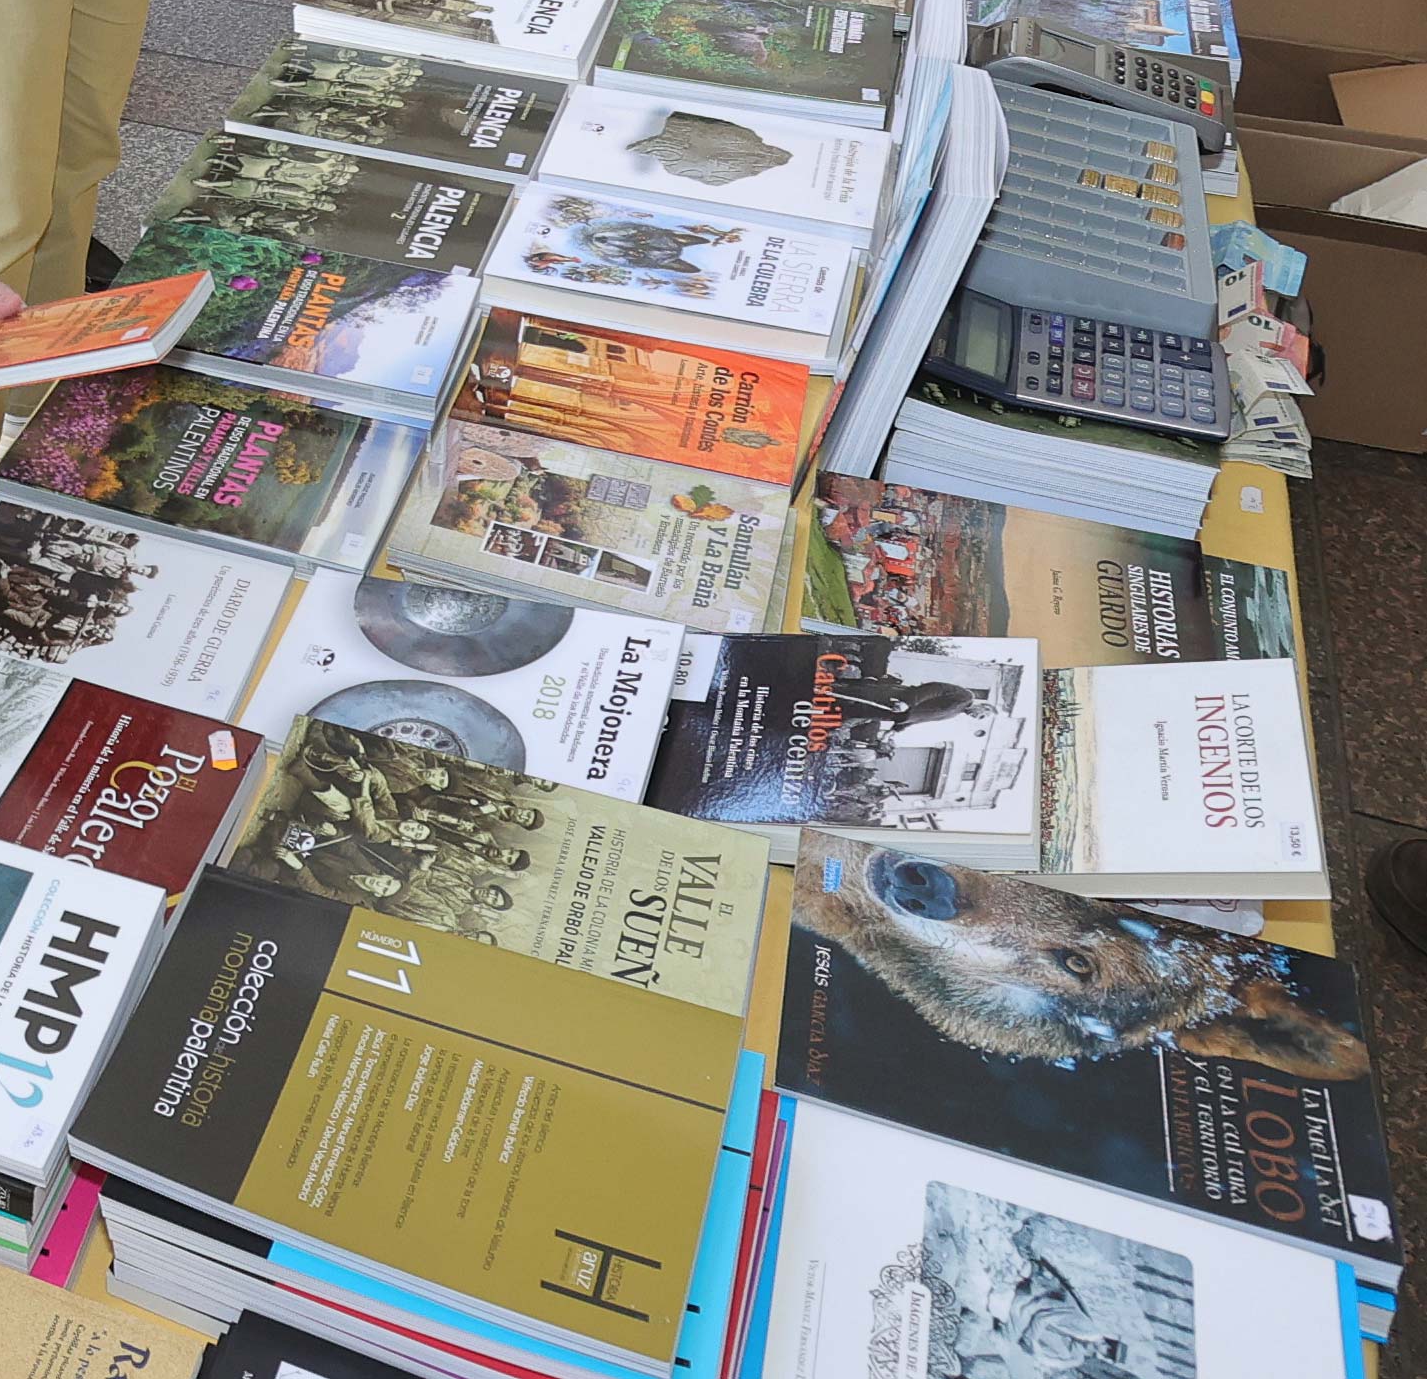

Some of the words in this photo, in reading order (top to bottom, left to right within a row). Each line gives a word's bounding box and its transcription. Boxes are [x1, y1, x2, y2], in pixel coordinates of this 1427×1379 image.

[452, 107, 466, 115] 2
[467, 85, 524, 151] PALENCIA
[390, 211, 406, 220] 2
[403, 184, 466, 262] PALENCIA
[759, 248, 781, 262] LA
[764, 235, 785, 249] DE
[276, 266, 305, 302] MONTAÑA
[299, 278, 313, 290] USO
[304, 269, 318, 280] DE
[744, 261, 777, 308] CULEBRA
[766, 259, 815, 316] SIERRA
[256, 299, 287, 340] PALENTINA
[280, 288, 308, 325] TRADICIONAL
[285, 270, 347, 350] PLANTAS
[271, 333, 284, 343] LA
[275, 324, 290, 335] EN
[713, 365, 735, 387] de
[707, 386, 729, 409] los
[730, 369, 761, 426] Carrión
[200, 410, 240, 456] PÁRAMOS
[226, 425, 246, 443] USO
[235, 415, 252, 428] DE
[696, 408, 725, 455] Condes
[151, 403, 220, 493] PALENTINOS
[195, 452, 212, 462] Y
[199, 439, 237, 489] TRADICIONAL
[209, 417, 284, 509] PLANTAS
[174, 458, 208, 496] VALLES
[192, 486, 210, 500] EN
[705, 524, 727, 536] y
[703, 538, 728, 558] La
[721, 514, 764, 590] Santullán
[690, 561, 725, 609] Braña
[1219, 571, 1234, 588] EL
[219, 578, 251, 620] DIARIO
[1094, 560, 1130, 648] GUARDO
[1125, 564, 1149, 634] SINGULARES
[1148, 569, 1179, 658] HISTORIAS
[1216, 585, 1239, 643] CONJUNTO
[210, 618, 231, 637] DE
[1133, 635, 1150, 653] DE
[186, 634, 223, 685] GUERRA
[620, 635, 650, 667] La
[674, 650, 693, 686] 10.80
[531, 673, 566, 721] 2018
[737, 688, 751, 698] la
[739, 676, 750, 687] en
[731, 698, 749, 736] Montaña
[751, 685, 769, 721] Historia
[790, 699, 825, 729] de
[803, 651, 851, 754] Castillos
[1230, 693, 1252, 710] LA
[104, 713, 132, 747] Historia
[580, 667, 642, 783] Mojonera
[747, 734, 761, 747] los
[750, 722, 764, 733] de
[1154, 721, 1169, 745] Ignacio
[1233, 715, 1258, 766] CORTE
[93, 755, 108, 766] la
[98, 745, 114, 757] de
[723, 737, 743, 779] Palentina
[743, 748, 759, 771] cines
[1156, 747, 1172, 772] Martín
[1192, 694, 1238, 828] INGENIOS
[76, 764, 103, 795] minería
[125, 743, 207, 828] Pozo
[780, 734, 819, 806] ceniza
[1159, 774, 1173, 800] Verona
[1239, 771, 1260, 793] DE
[65, 804, 80, 814] el
[70, 793, 84, 805] en
[1242, 797, 1264, 828] LOS
[46, 833, 63, 846] de
[53, 812, 75, 835] Valle
[563, 817, 580, 837] JOSÉ
[1288, 826, 1300, 847] 13,50
[576, 823, 608, 880] VALLEJO
[600, 828, 628, 877] HISTORIA
[657, 849, 675, 868] DE
[572, 881, 591, 899] DE
[597, 877, 614, 894] DE
[651, 868, 672, 893] LOS
[26, 877, 63, 935] COLECCIÓN
[562, 900, 591, 937] ORBÓ
[594, 894, 610, 908] LA
[655, 846, 730, 960] VALLE
[718, 903, 735, 918] EL
[531, 904, 553, 949] FERNANDO
[581, 909, 607, 955] COLONIA
[5, 933, 36, 980] HISTORIA
[346, 940, 422, 995] 11
[810, 944, 833, 988] JESÚS
[216, 937, 287, 1047] colección
[1194, 1099, 1225, 1201] TERRITORIO
[1239, 1073, 1312, 1226] LOBO
[575, 1249, 599, 1290] aruz
[904, 1291, 925, 1351] IMÁGENES
[905, 1354, 918, 1371] DE
